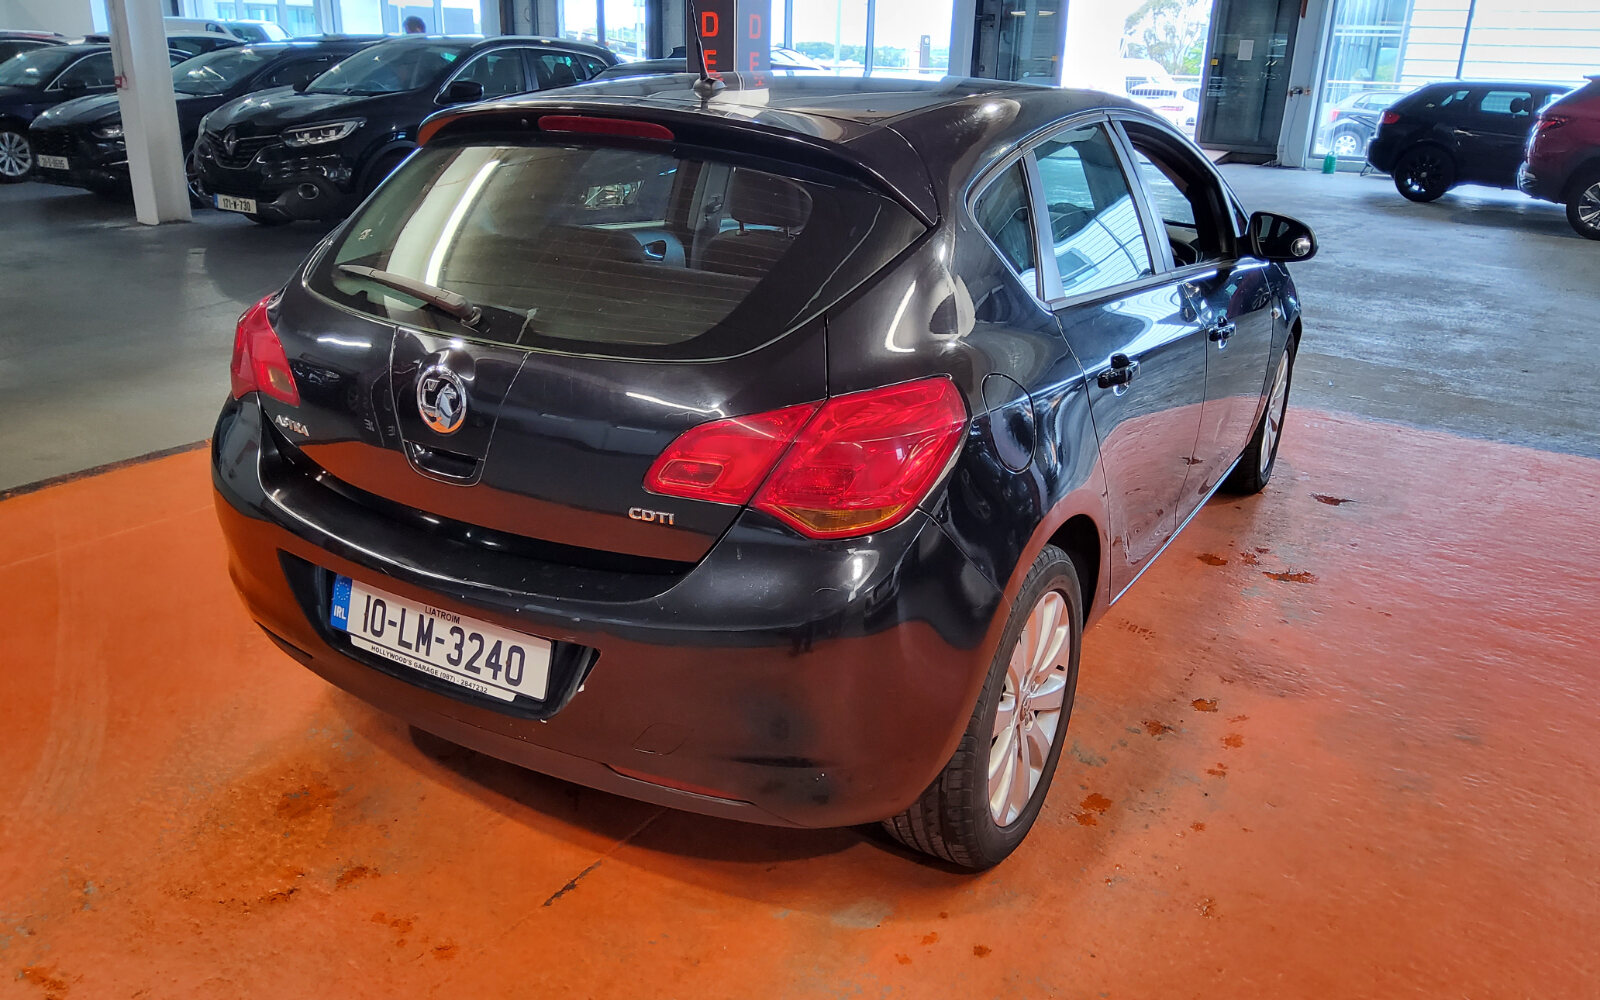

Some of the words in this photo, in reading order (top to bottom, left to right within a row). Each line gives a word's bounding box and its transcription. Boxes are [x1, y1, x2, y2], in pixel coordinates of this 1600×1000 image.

[274, 414, 310, 437] ASTRA
[333, 604, 347, 620] IRL
[362, 594, 526, 687] 10-LM-3240
[371, 645, 413, 666] HOLLYWOOD'S
[413, 662, 439, 677] GARAGE
[439, 671, 456, 683] (087)
